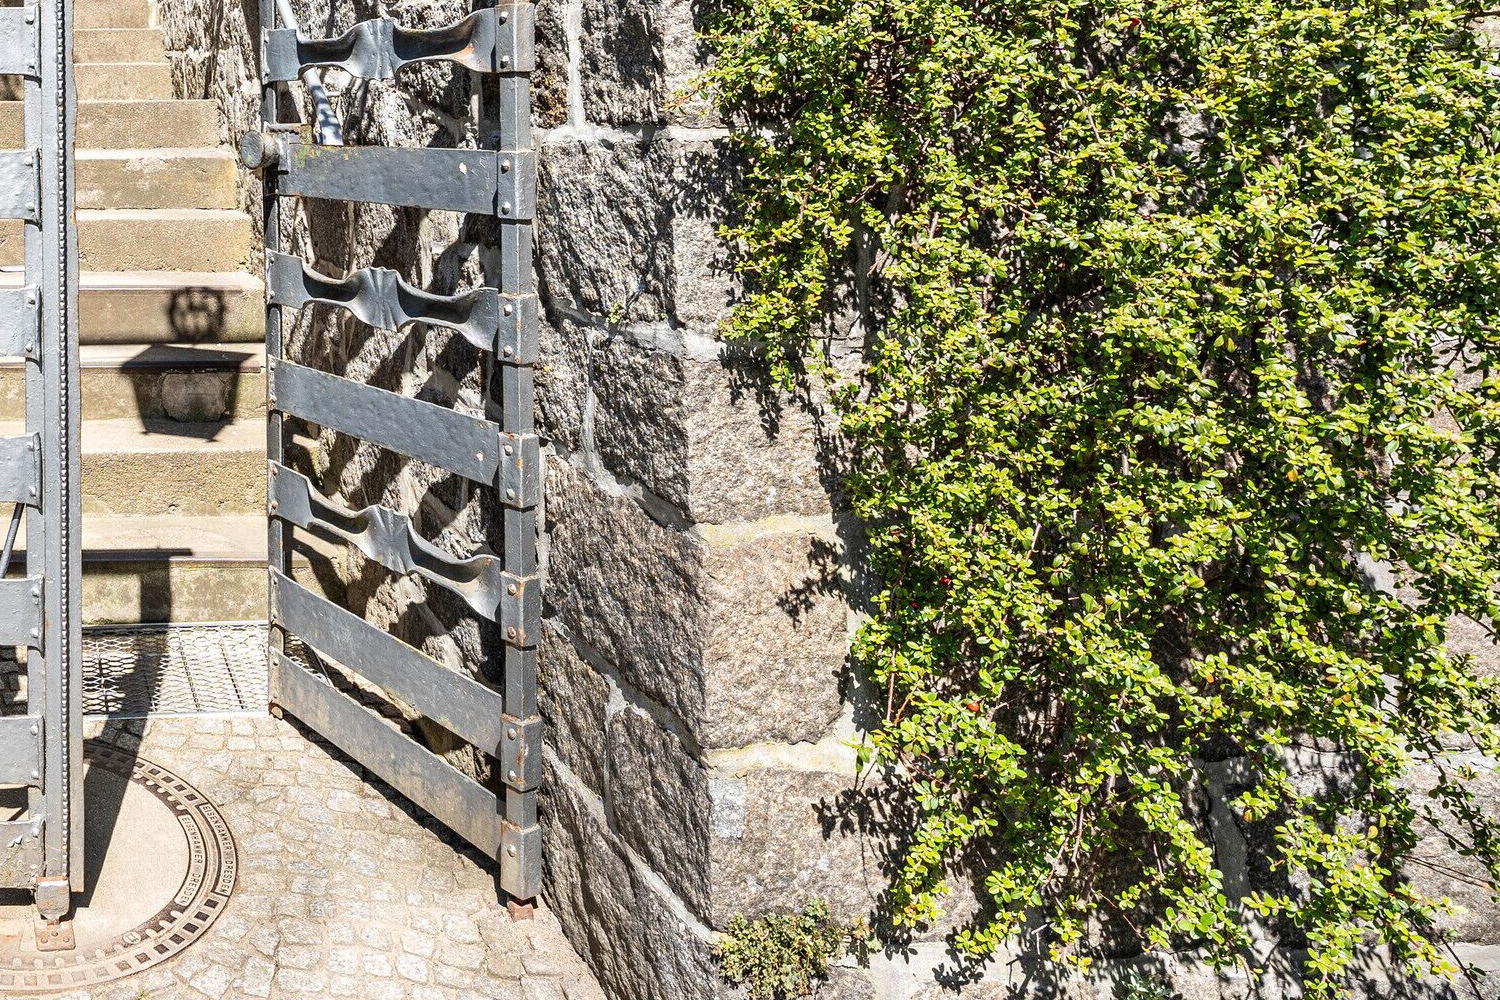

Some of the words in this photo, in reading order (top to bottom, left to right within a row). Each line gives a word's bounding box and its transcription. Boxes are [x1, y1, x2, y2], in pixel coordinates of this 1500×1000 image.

[181, 817, 203, 864] EISENHAMMER
[202, 805, 232, 855] EISENHAMMER
[220, 860, 234, 894] DRESDEN
[179, 872, 201, 904] DRESDEN
